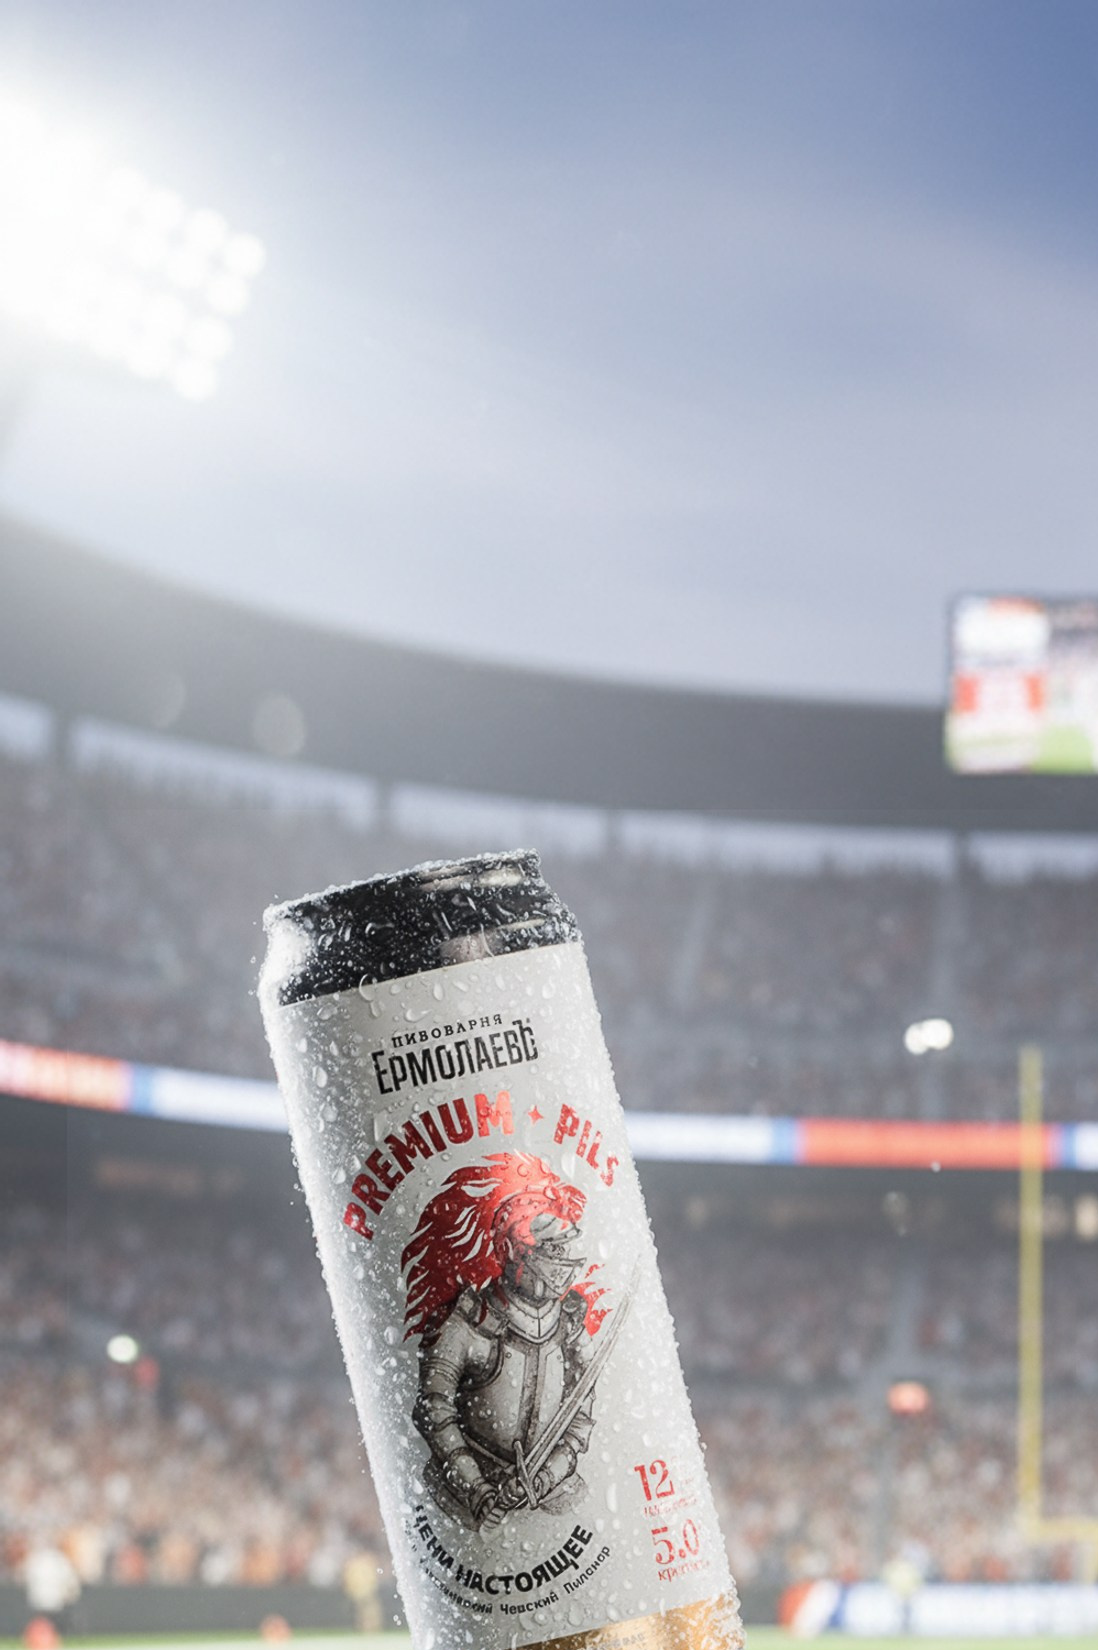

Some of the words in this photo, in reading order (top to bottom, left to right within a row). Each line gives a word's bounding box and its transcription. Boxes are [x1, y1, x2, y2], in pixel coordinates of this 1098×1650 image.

[391, 1013, 502, 1048] ПИВОВАРНЯ
[343, 1090, 513, 1241] PREMIUM
[553, 1103, 619, 1187] PILS
[634, 1459, 675, 1501] 12
[455, 1524, 593, 1596] НАСТОЯЩЕЕ
[651, 1518, 699, 1565] 5.0
